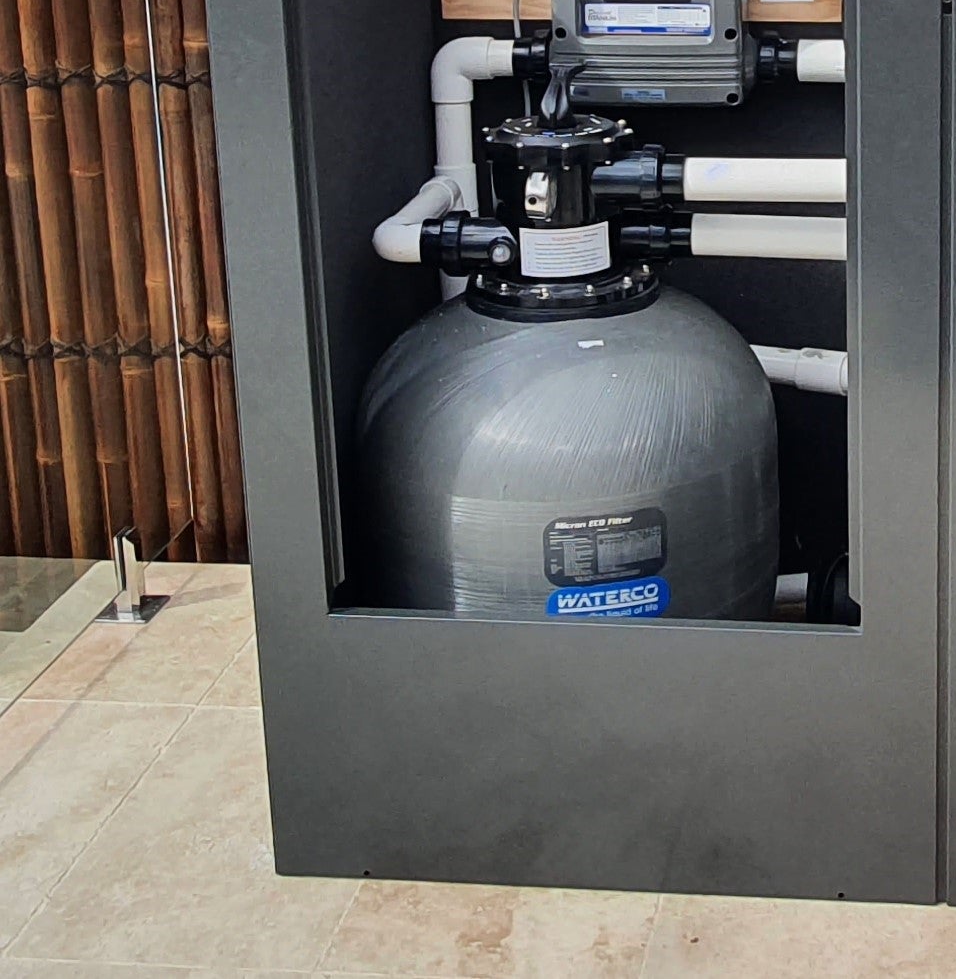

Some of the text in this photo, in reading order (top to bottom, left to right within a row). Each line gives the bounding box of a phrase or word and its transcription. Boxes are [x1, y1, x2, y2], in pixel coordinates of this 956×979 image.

[554, 516, 633, 530] Micron ECO Filter
[557, 583, 659, 609] WATERCO
